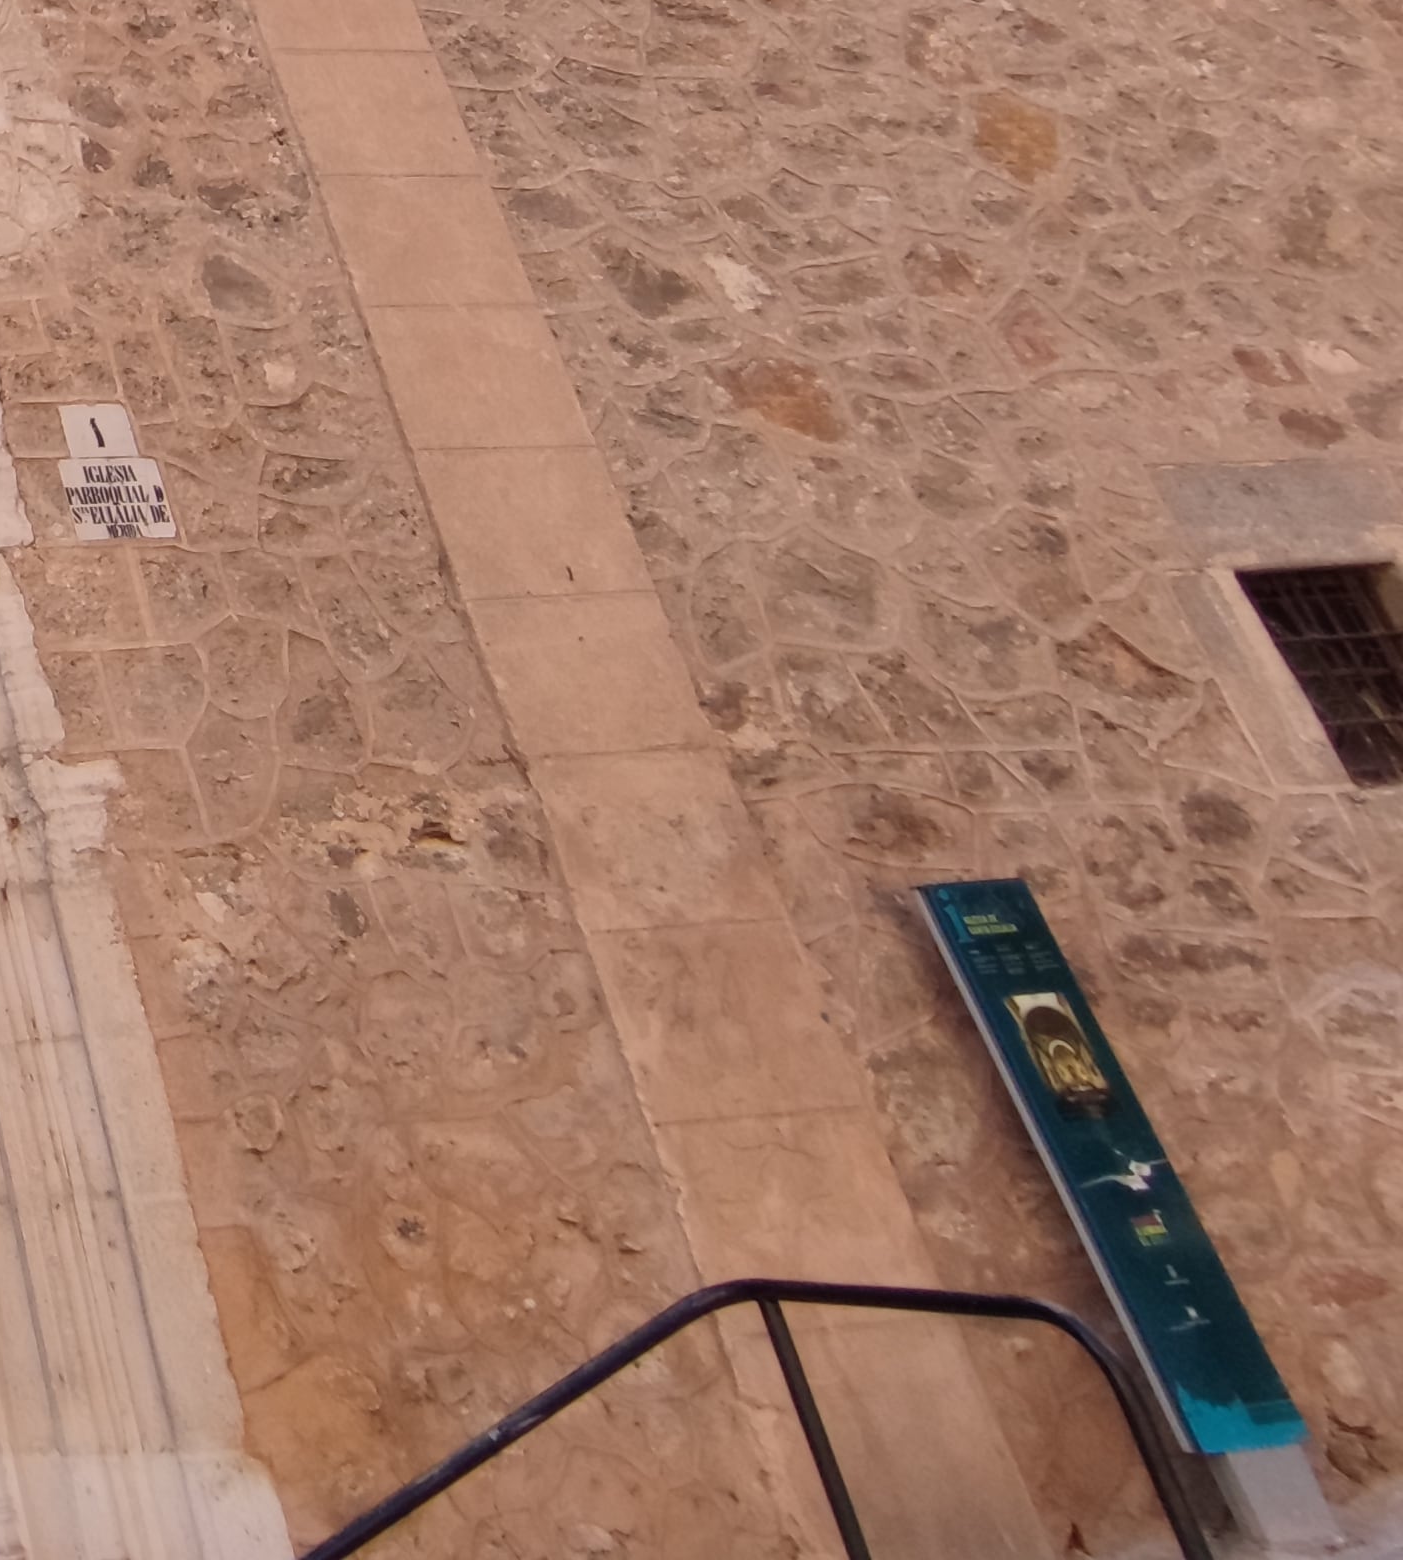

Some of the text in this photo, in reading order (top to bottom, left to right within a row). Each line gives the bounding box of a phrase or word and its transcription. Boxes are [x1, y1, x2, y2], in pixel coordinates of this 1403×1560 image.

[89, 417, 106, 448] 1
[82, 464, 138, 484] IGLESIA
[65, 484, 150, 506] PARROQUIAL
[90, 504, 149, 526] EULALIA
[149, 504, 171, 524] DE
